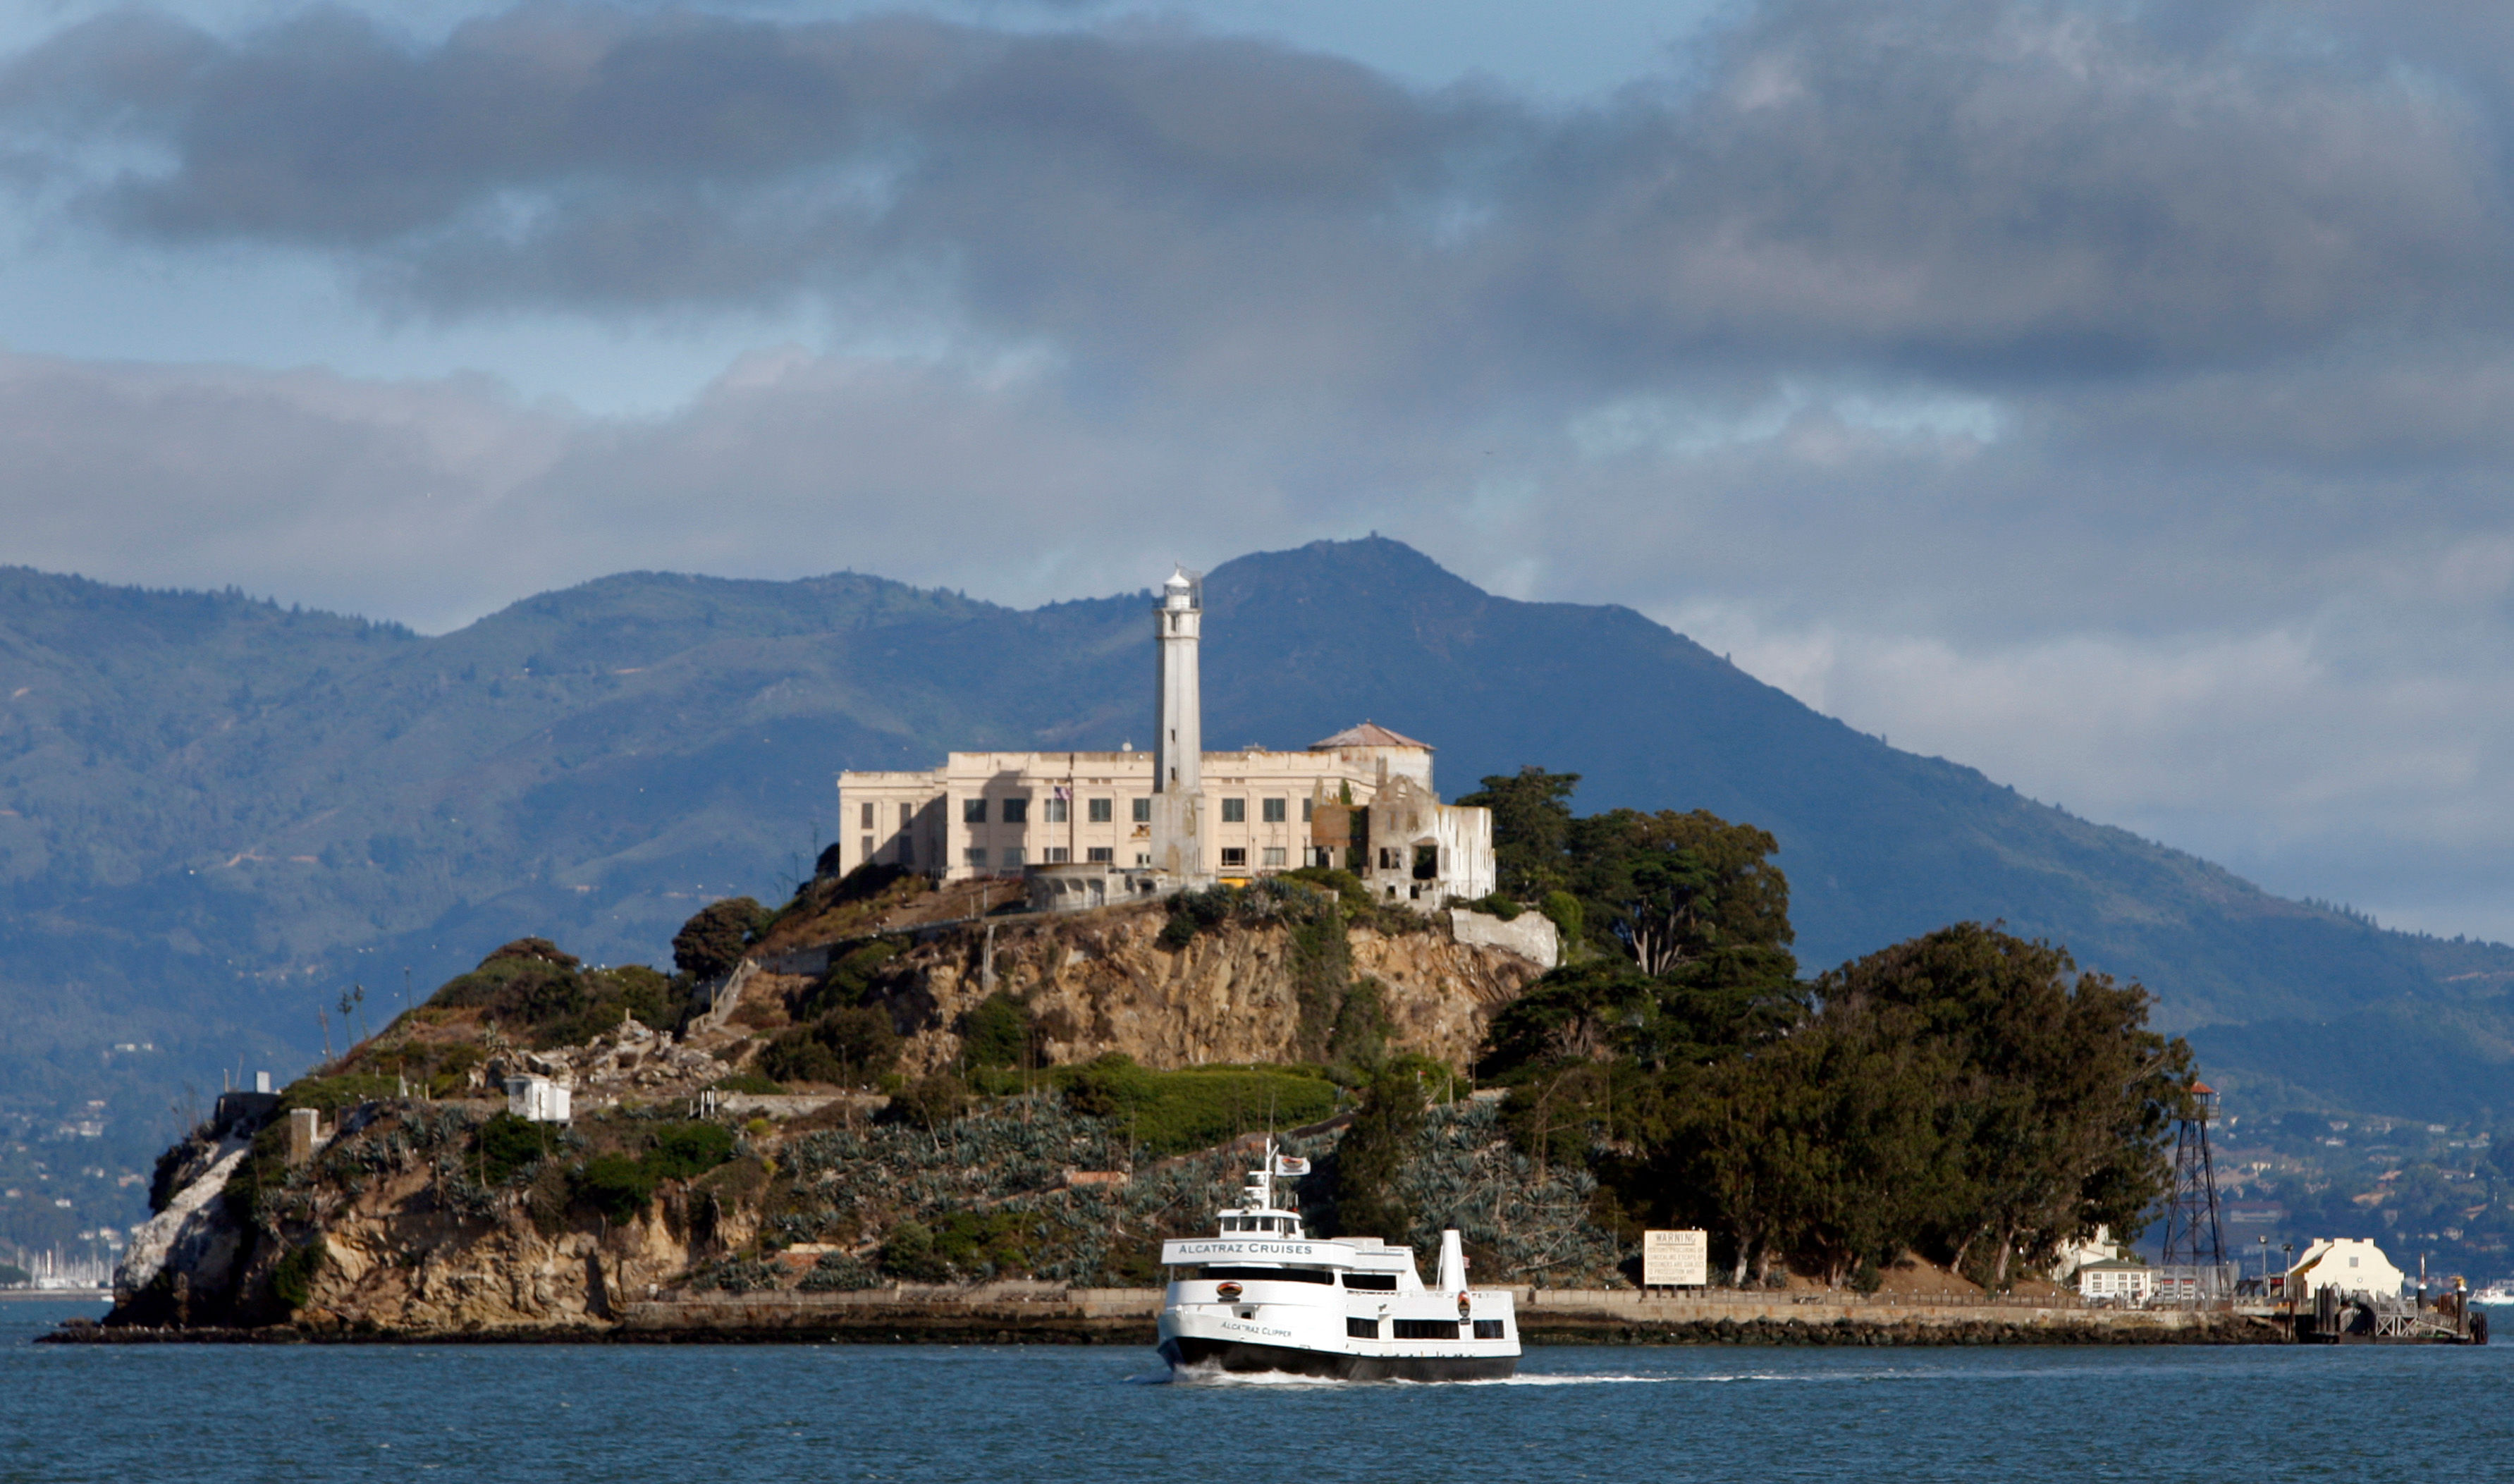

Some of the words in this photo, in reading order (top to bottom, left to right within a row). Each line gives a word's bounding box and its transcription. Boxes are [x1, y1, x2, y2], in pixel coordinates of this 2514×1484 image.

[1656, 1233, 1696, 1243] WARNING
[1179, 1244, 1244, 1253] ALCATRAZ
[1249, 1243, 1312, 1254] CRUISES
